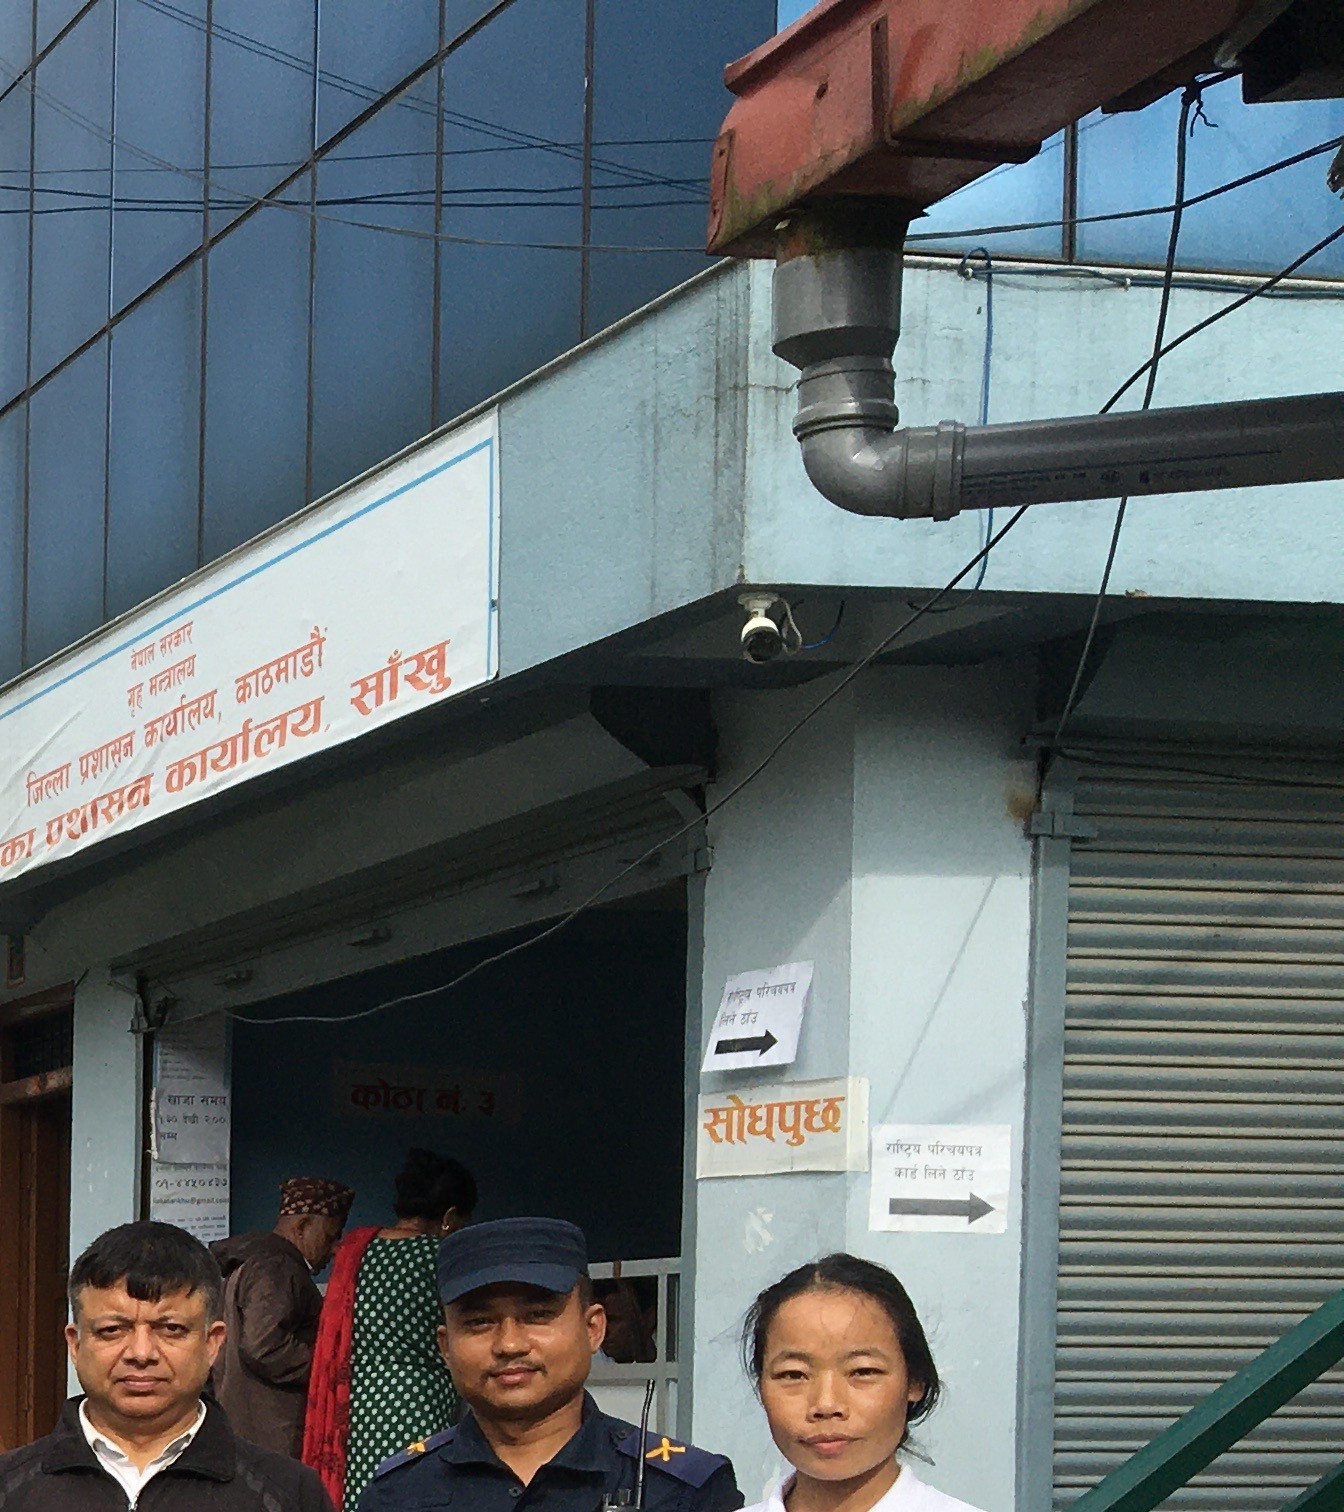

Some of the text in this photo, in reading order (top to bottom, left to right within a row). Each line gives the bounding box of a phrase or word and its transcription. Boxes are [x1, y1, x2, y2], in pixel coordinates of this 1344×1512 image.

[131, 621, 193, 670] नेपाल सरकार
[127, 654, 197, 717] गृह मन्त्रालय
[26, 625, 328, 807] जिल्ला प्रशासन कार्यालय, काठमाडौं
[46, 772, 154, 847] प्रशासन
[165, 695, 331, 794] कार्यालय,
[350, 639, 452, 716] साँखु
[351, 1078, 427, 1113] कोठा
[703, 1094, 846, 1147] सोधपुछ
[894, 1164, 918, 1180] कार्ड
[924, 1164, 947, 1180] लिने
[928, 1141, 982, 1157] परिचयपत्र
